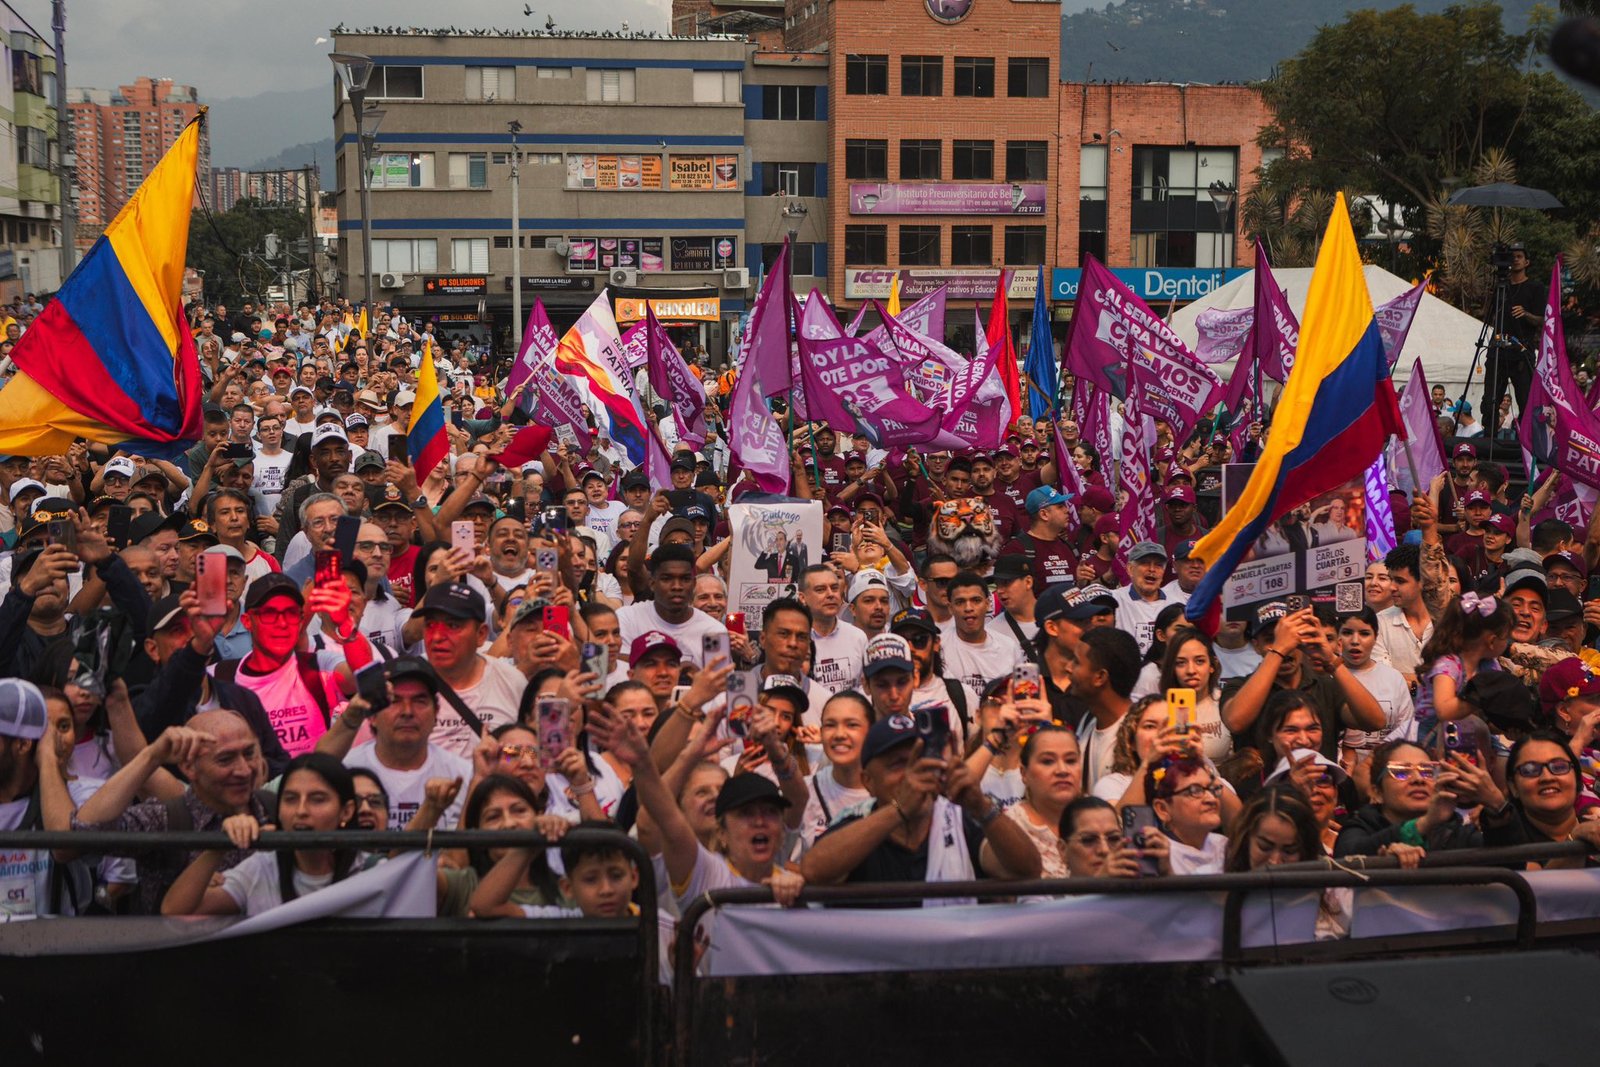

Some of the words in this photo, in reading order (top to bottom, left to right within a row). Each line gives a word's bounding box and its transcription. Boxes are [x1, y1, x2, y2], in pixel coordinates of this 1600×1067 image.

[671, 161, 711, 172] Isabel
[929, 188, 988, 199] Preuniversitario
[988, 188, 999, 199] de
[1000, 188, 1013, 199] Bel
[448, 278, 486, 286] SOLUCIONES
[853, 272, 896, 283] ICCT
[639, 302, 647, 317] L
[656, 302, 718, 316] CHOCOLERA
[1104, 287, 1123, 309] AL
[1123, 302, 1184, 347] SENADO
[842, 343, 869, 361] LA
[602, 346, 634, 398] PATRIA
[819, 370, 848, 386] OTE
[852, 357, 891, 379] POR
[1165, 383, 1196, 405] GENTE
[562, 404, 585, 426] GENTE
[1569, 429, 1600, 453] DEFEN
[1566, 446, 1600, 475] PAT
[1315, 548, 1345, 562] CARLOS
[1315, 555, 1351, 571] CUARTAS
[1231, 569, 1262, 582] MANUELA
[1262, 561, 1293, 575] CUARTAS
[1344, 566, 1353, 577] 9
[1265, 577, 1284, 590] 108
[868, 647, 905, 662] PATRIA
[821, 663, 840, 673] LISTA
[266, 705, 308, 720] SORES
[275, 725, 311, 745] RIA
